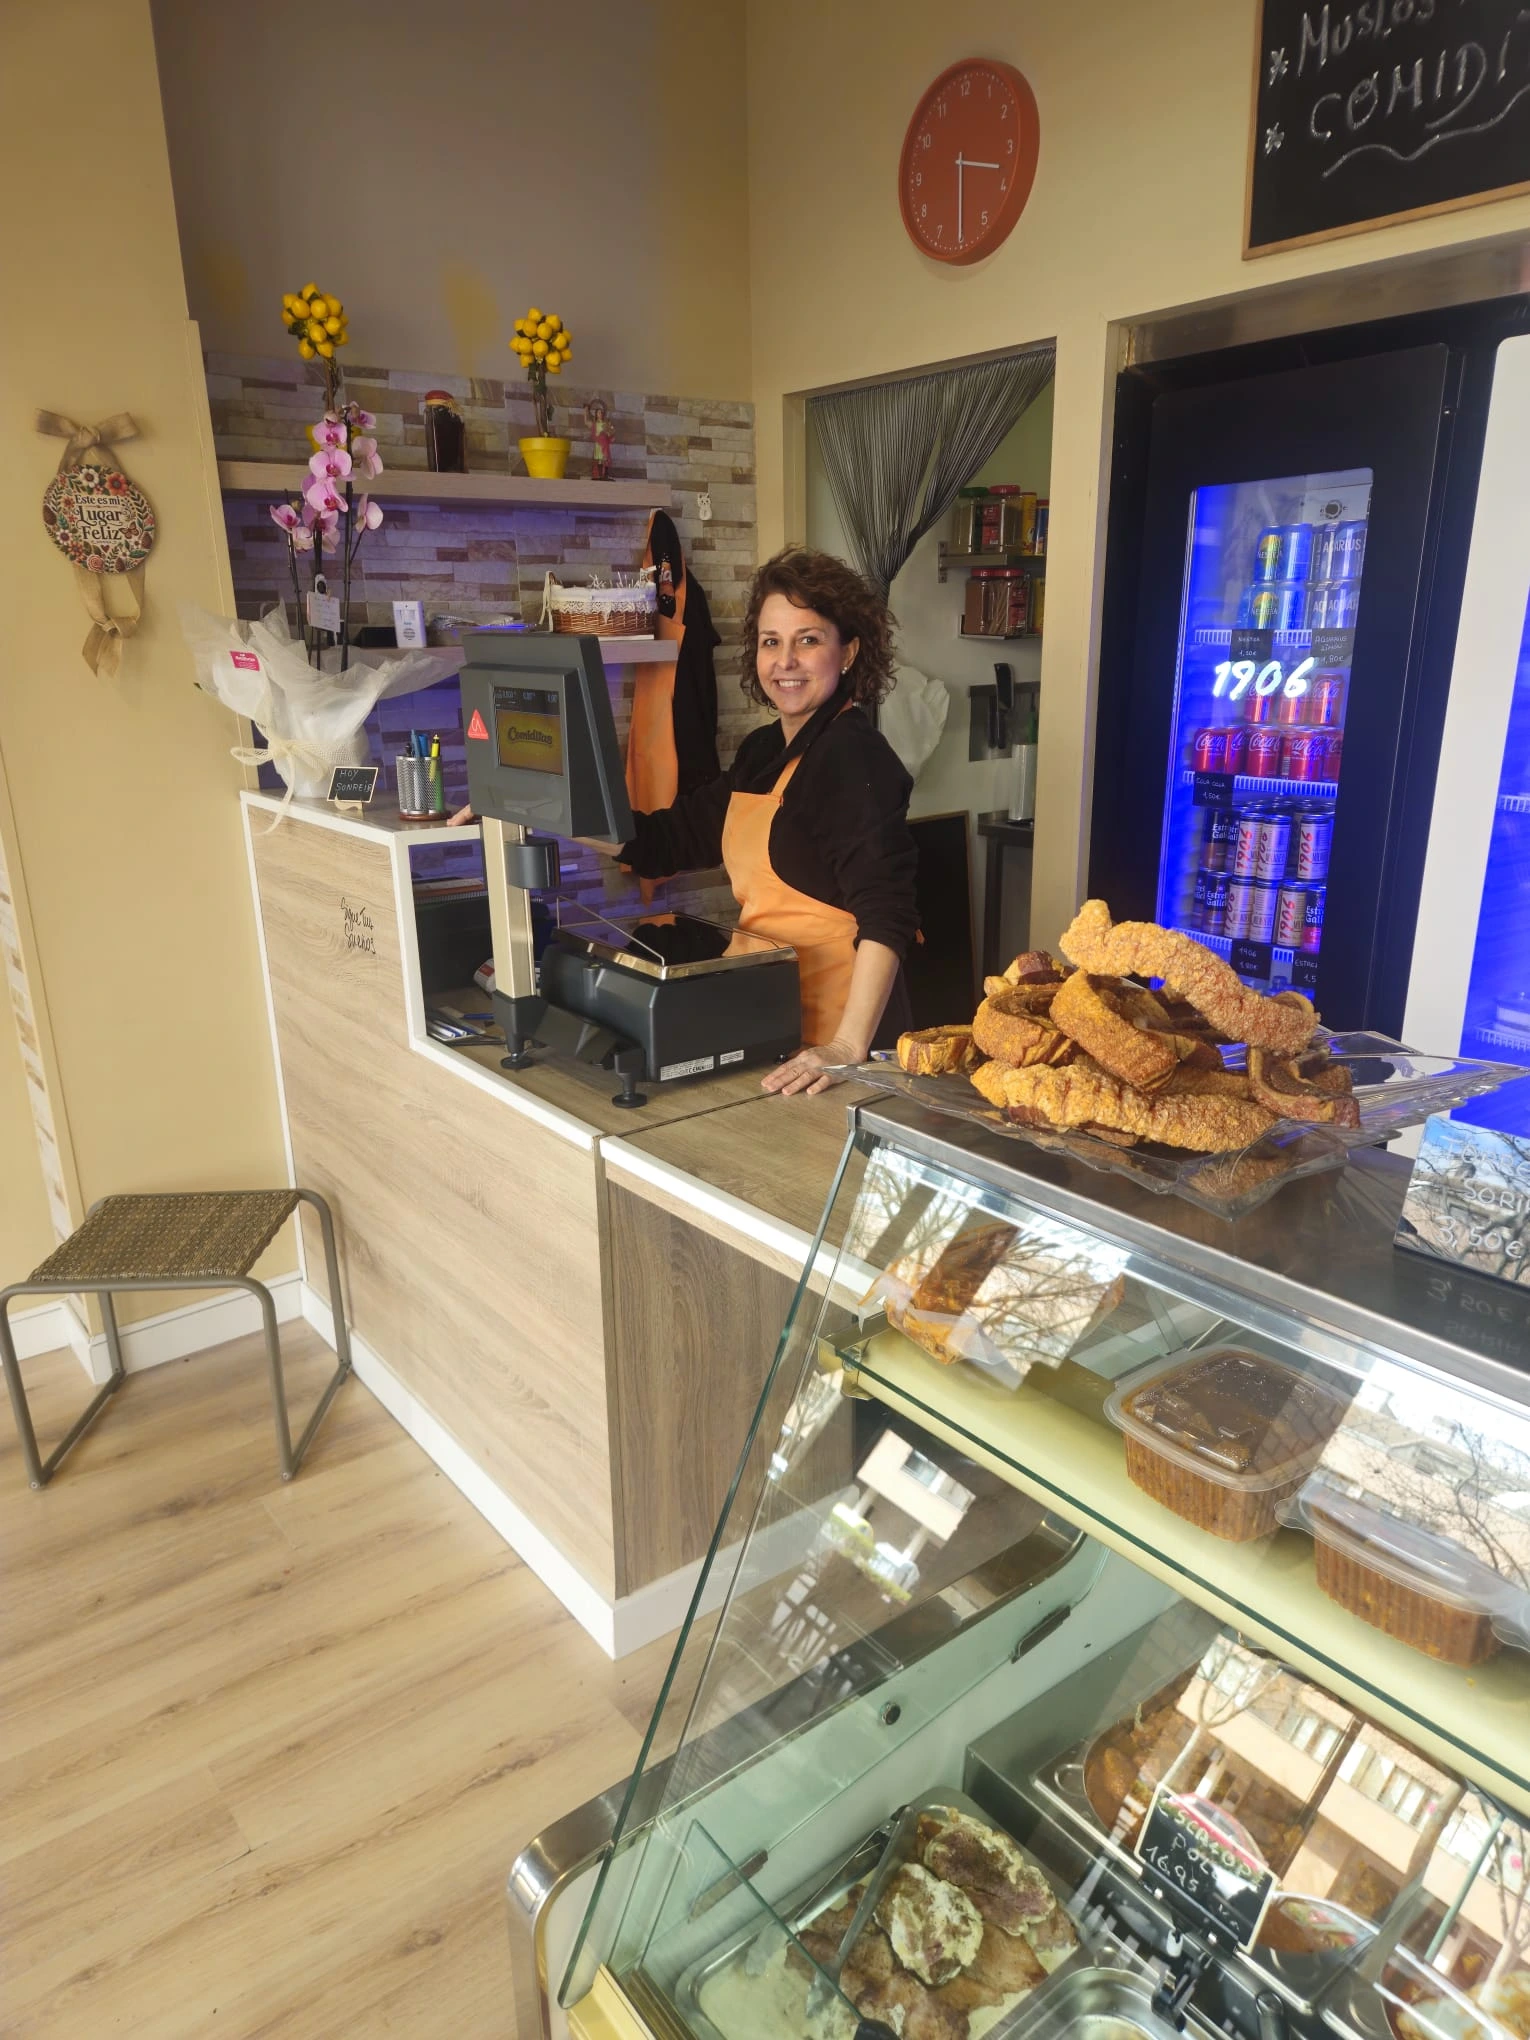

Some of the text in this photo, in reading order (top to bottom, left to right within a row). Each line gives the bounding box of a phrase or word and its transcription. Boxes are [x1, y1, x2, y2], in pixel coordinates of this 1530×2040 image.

[960, 80, 971, 97] 12
[987, 83, 992, 99] 1
[938, 102, 947, 119] 11
[1000, 104, 1008, 120] 2
[922, 133, 931, 150] 10
[1007, 138, 1014, 155] 3
[915, 172, 922, 187] 9
[1000, 177, 1007, 192] 4
[921, 203, 927, 218] 8
[981, 210, 989, 225] 5
[936, 224, 943, 239] 7
[75, 494, 121, 505] Este es mi
[75, 505, 122, 526] Lugar
[81, 525, 122, 540] Feliz
[1212, 656, 1316, 701] 1906
[339, 769, 360, 781] HOY
[1236, 827, 1253, 870] 1906
[1299, 830, 1314, 872] 1906
[1279, 896, 1296, 939] 1906
